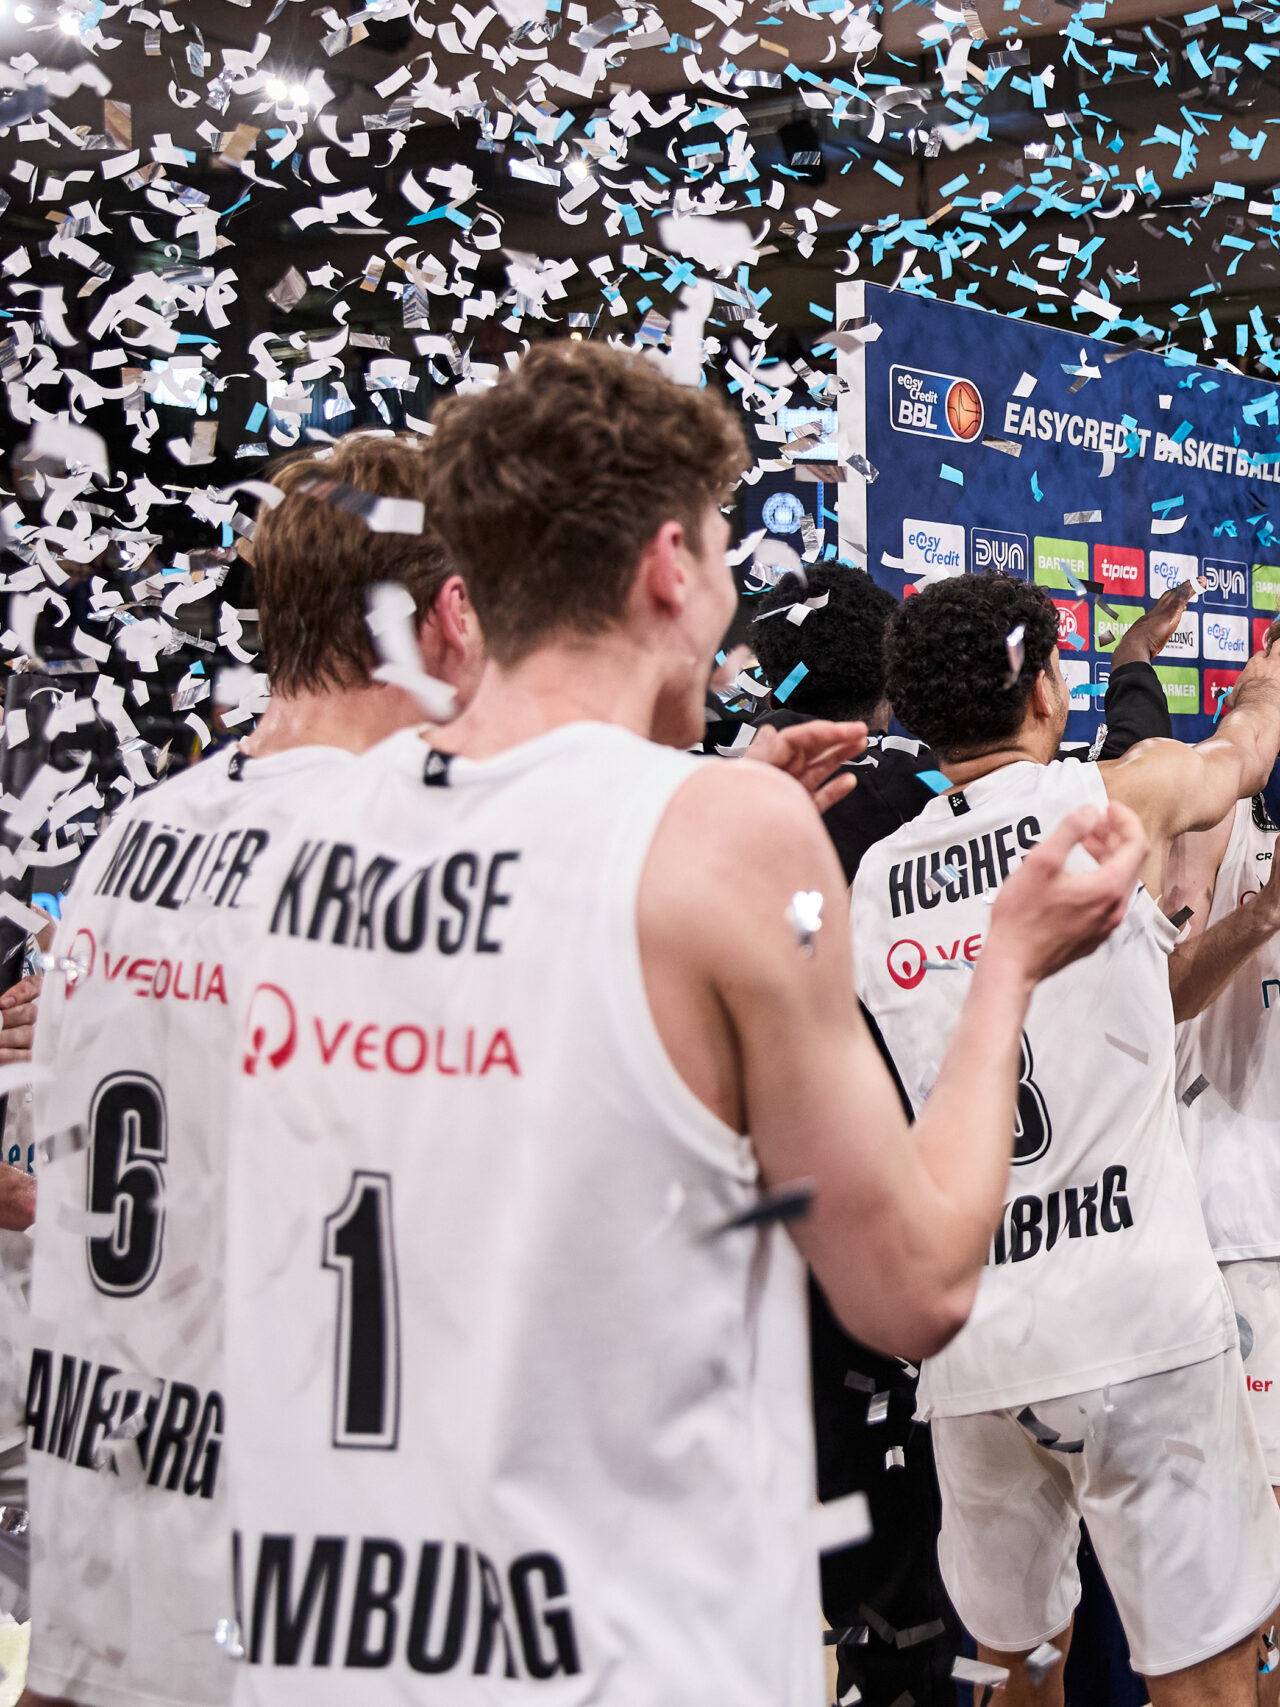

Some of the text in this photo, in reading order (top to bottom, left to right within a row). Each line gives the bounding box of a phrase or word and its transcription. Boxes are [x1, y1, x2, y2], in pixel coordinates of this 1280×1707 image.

[898, 399, 938, 430] BBL
[909, 388, 938, 405] Credit
[1003, 401, 1151, 458] EASYCREDT
[924, 548, 960, 567] Credit
[1038, 555, 1085, 573] BARMER
[1101, 558, 1138, 581] tipico
[1166, 576, 1182, 590] Cre
[1098, 621, 1132, 636] BARM
[1168, 631, 1194, 647] LDING
[1218, 637, 1245, 652] Credit
[1162, 683, 1196, 697] ARMER
[93, 819, 270, 911] MÖLER
[889, 815, 1042, 919] HUGHES
[268, 839, 522, 955] KRAUSE
[104, 951, 229, 1005] VEOLIA
[313, 1014, 523, 1077] VEOLIA
[86, 1069, 168, 1299] 6
[996, 1165, 1134, 1264] BURG
[321, 1169, 400, 1451] 1
[1246, 1375, 1273, 1392] ler
[26, 1347, 225, 1500] AMBURG
[233, 1531, 582, 1680] MBURG
